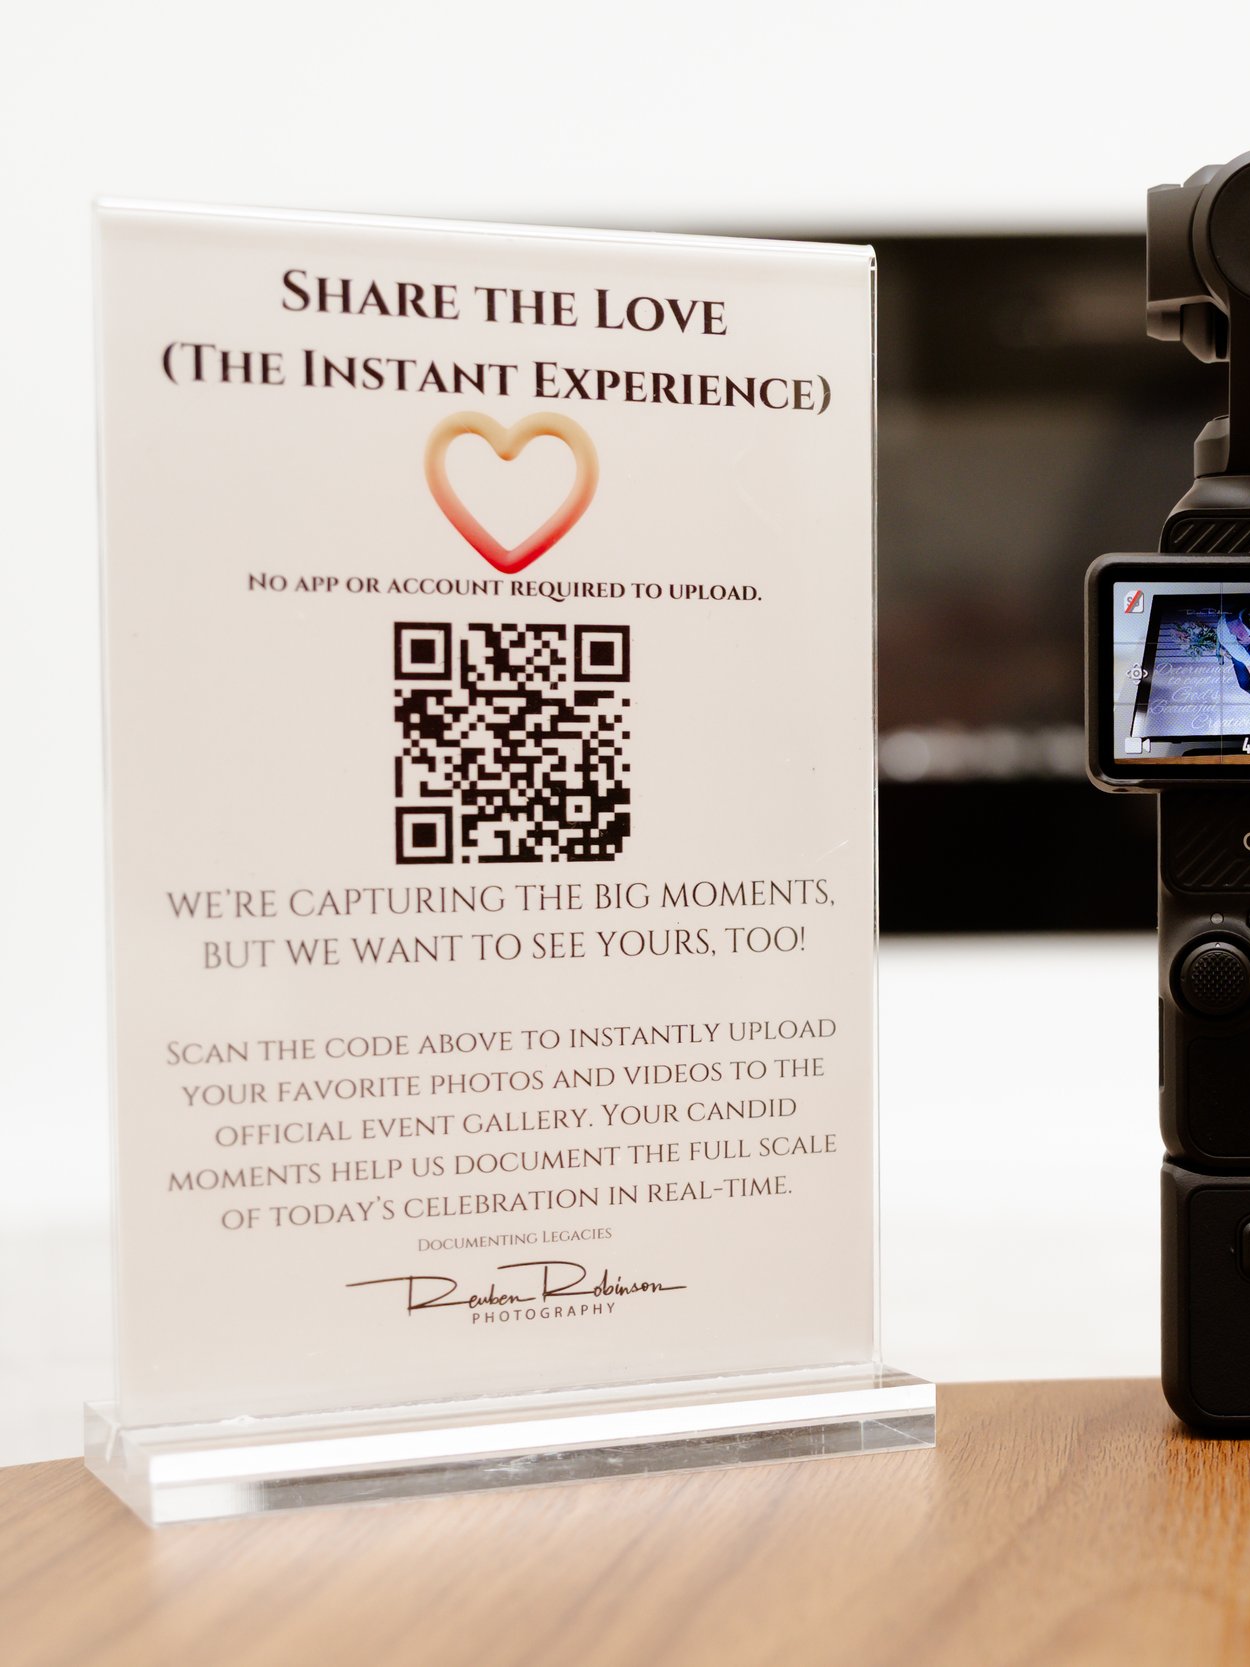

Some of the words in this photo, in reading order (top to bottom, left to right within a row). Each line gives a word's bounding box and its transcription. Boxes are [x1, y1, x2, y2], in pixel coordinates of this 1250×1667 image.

[283, 270, 459, 319] SHARE
[475, 287, 577, 326] THE
[596, 289, 727, 335] LOVE
[162, 343, 284, 385] (THE
[304, 350, 518, 395] INSTANT
[534, 362, 831, 415] EXPERIENCE)
[249, 573, 287, 591] NO
[295, 576, 339, 592] APP
[346, 577, 380, 593] OR
[388, 579, 503, 595] ACCOUNT
[512, 581, 625, 602] REQUIRED
[631, 583, 662, 599] TO
[670, 584, 761, 601] UPLOAD.
[167, 889, 277, 919] WE'RE
[289, 886, 504, 916] CAPTURING
[515, 884, 582, 910] THE
[596, 883, 649, 909] BIG
[661, 879, 834, 907] MOMENTS,
[204, 939, 275, 969] BUT
[285, 938, 339, 965] WE
[352, 935, 463, 963] WANT
[472, 934, 521, 960] TO
[533, 932, 585, 959] SEE
[597, 929, 715, 956] YOURS,
[725, 926, 804, 953] TOO!
[167, 1041, 248, 1065] SCAN
[257, 1039, 315, 1061] THE
[325, 1036, 409, 1058] CODE
[419, 1032, 512, 1054] ABOVE
[521, 1030, 560, 1049] TO
[570, 1023, 720, 1048] INSTANTLY
[729, 1019, 836, 1041] UPLOAD
[182, 1083, 267, 1106] YOUR
[279, 1076, 420, 1102] FAVORITE
[432, 1070, 543, 1094] PHOTOS
[553, 1068, 615, 1088] AND
[624, 1062, 722, 1084] VIDEOS
[730, 1060, 766, 1080] TO
[774, 1058, 824, 1078] THE
[215, 1121, 351, 1147] OFFICIAL
[362, 1115, 455, 1139] EVENT
[463, 1109, 592, 1133] GALLERY.
[601, 1104, 679, 1126] YOUR
[687, 1098, 796, 1121] CANDID
[168, 1163, 321, 1191] MOMENTS
[332, 1159, 402, 1182] HELP
[412, 1156, 444, 1177] US
[456, 1146, 620, 1174] DOCUMENT
[628, 1143, 679, 1164] THE
[690, 1140, 750, 1160] FULL
[760, 1134, 836, 1156] SCALE
[221, 1208, 260, 1230] OF
[269, 1196, 395, 1227] TODAY'S
[404, 1188, 598, 1218] CELEBRATION
[610, 1185, 637, 1205] IN
[649, 1176, 792, 1202] REAL-TIME.
[418, 1233, 537, 1251] DOCUMENTING
[543, 1228, 612, 1243] LEGACIES
[345, 1273, 536, 1316] Reuben
[498, 1260, 687, 1303] Robinson
[472, 1302, 615, 1324] PHOTOGRAPHY
